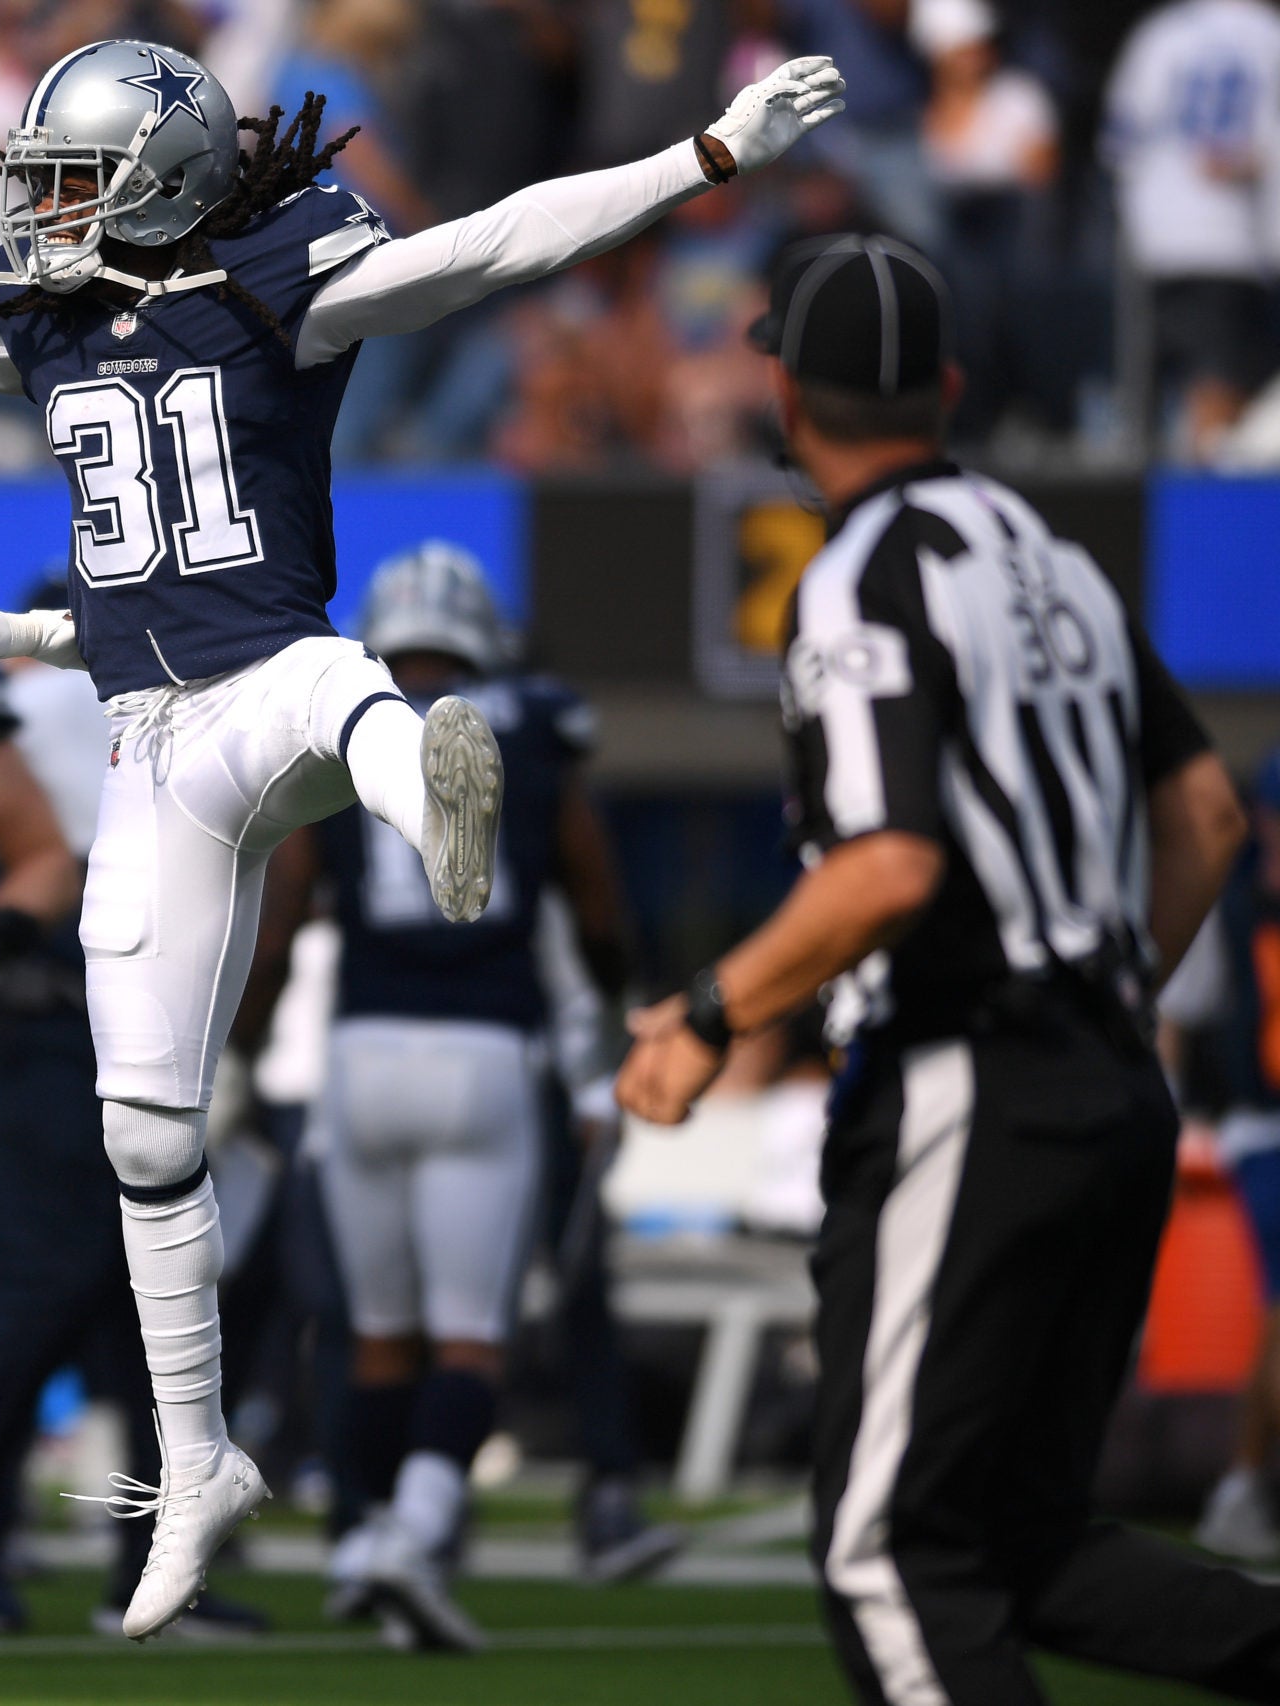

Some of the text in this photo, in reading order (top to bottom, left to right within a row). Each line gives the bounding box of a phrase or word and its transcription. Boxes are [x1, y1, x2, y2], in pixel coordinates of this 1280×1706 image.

[97, 359, 158, 375] COWBOYS
[45, 365, 264, 588] 31
[1011, 603, 1096, 683] 30
[457, 829, 465, 875] ARMOUR
